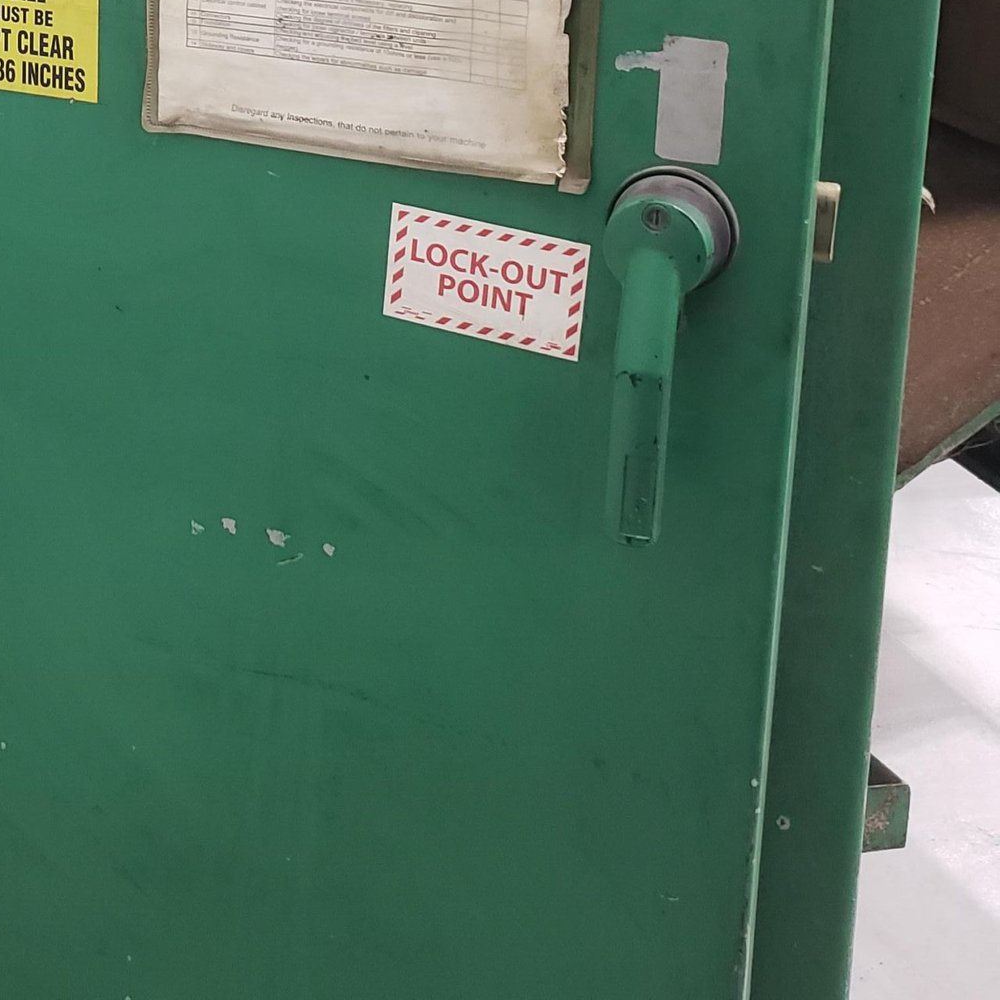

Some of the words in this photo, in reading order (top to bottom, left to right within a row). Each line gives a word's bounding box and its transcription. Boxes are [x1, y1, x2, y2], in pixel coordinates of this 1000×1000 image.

[35, 10, 53, 27] BE
[18, 30, 74, 60] CLEAR
[22, 61, 85, 92] INCHES
[231, 104, 268, 118] Disregard
[271, 111, 284, 121] any
[338, 122, 353, 131] that
[355, 123, 366, 132] do
[369, 126, 382, 135] not
[385, 128, 414, 139] pertain
[417, 131, 426, 139] to
[427, 133, 447, 143] your
[450, 136, 486, 149] machine
[411, 239, 568, 294] LOCK-OUT
[438, 274, 533, 315] POINT
